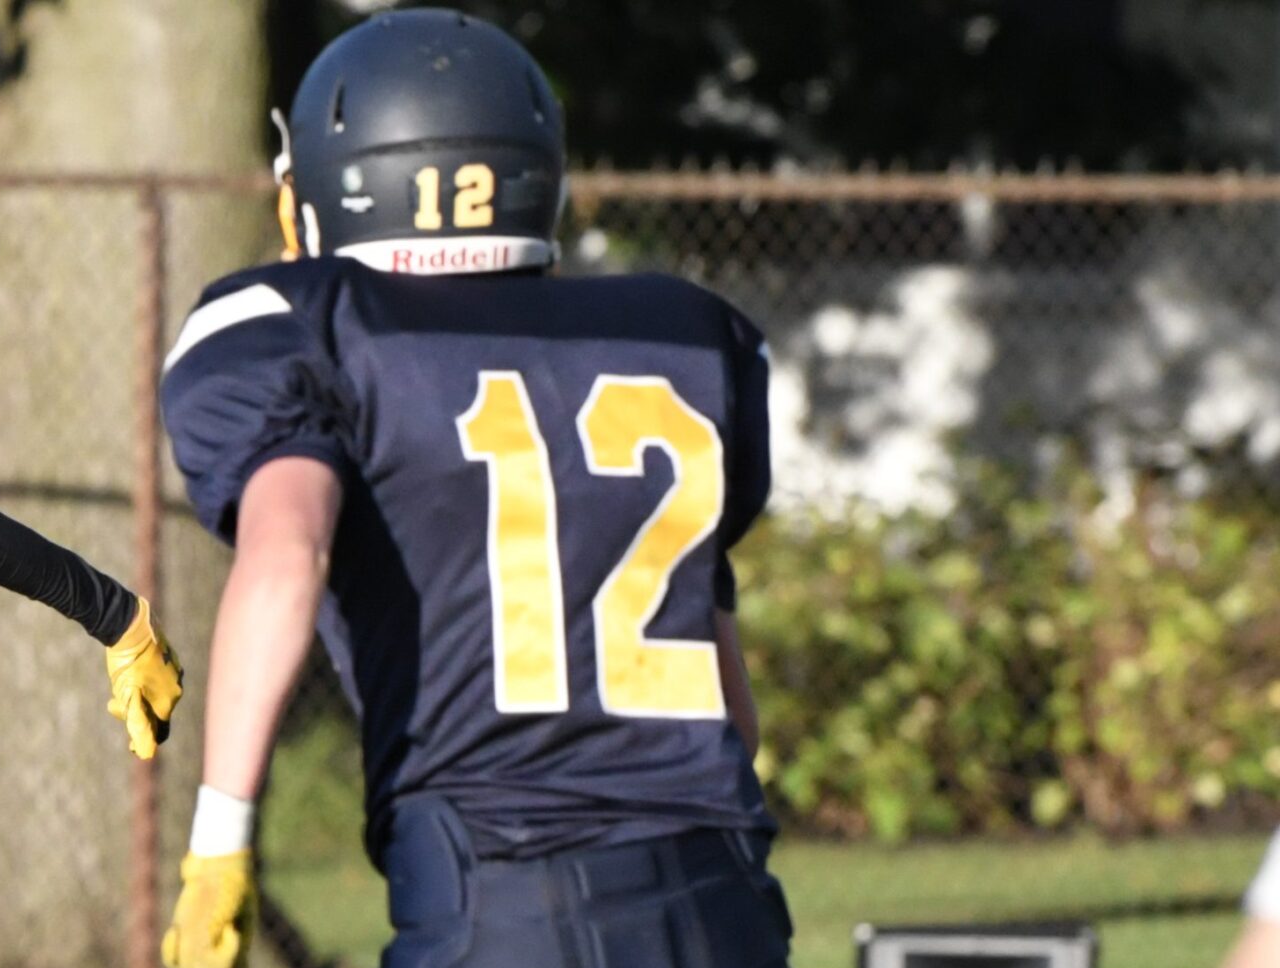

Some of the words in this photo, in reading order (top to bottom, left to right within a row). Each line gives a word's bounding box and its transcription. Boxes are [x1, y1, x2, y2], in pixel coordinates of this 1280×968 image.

[414, 163, 496, 231] 12
[391, 246, 511, 274] Riddell
[454, 369, 727, 720] 12
